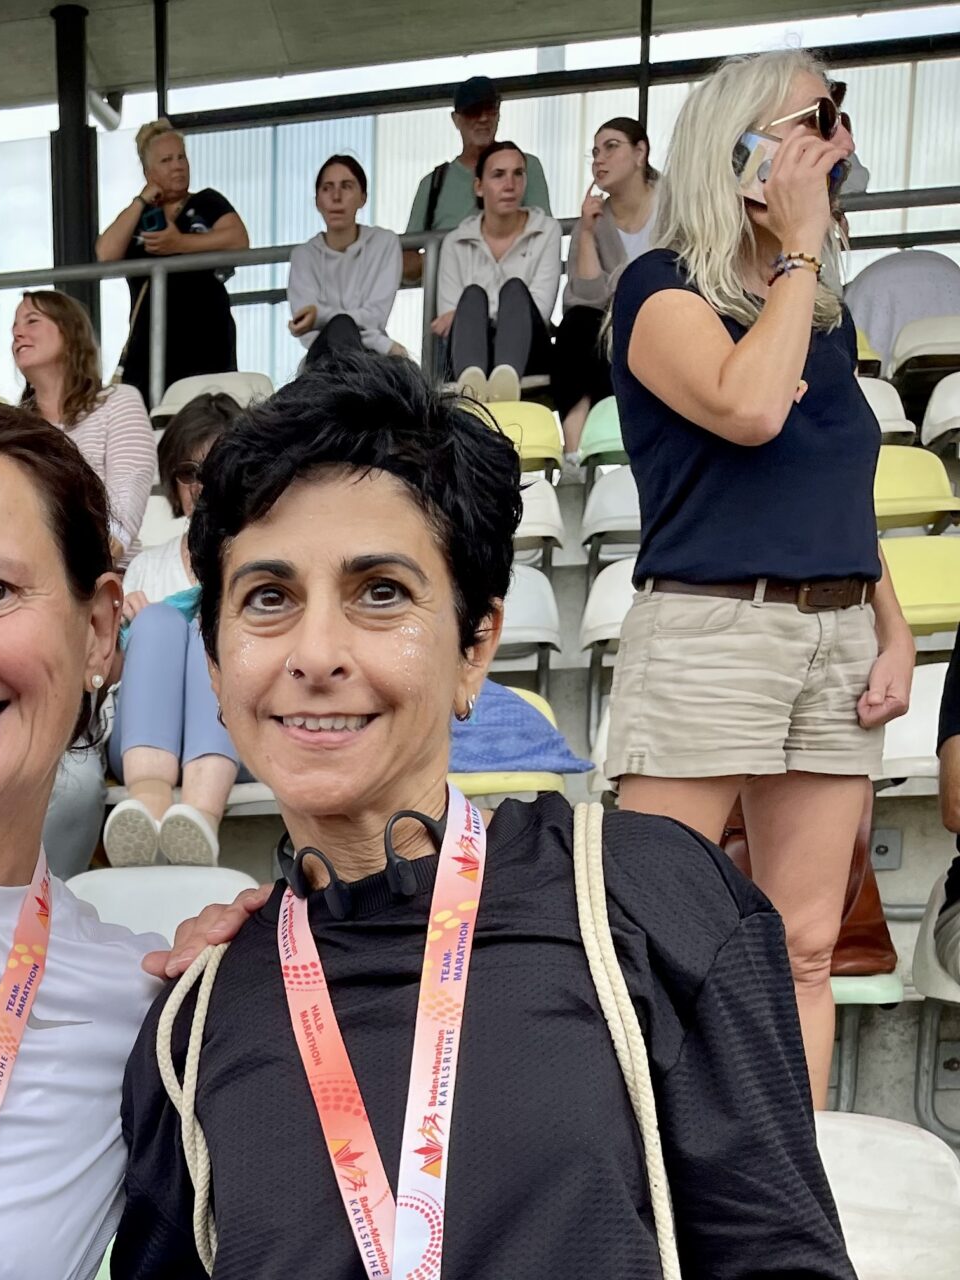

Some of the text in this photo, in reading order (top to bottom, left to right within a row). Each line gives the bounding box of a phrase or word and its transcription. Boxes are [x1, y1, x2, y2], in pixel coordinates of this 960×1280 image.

[281, 907, 293, 961] KARLSRUHE
[453, 921, 470, 982] MARATHON
[15, 962, 40, 1019] MARATHON
[440, 948, 453, 984] TEAM-
[5, 983, 21, 1013] TEAM-
[310, 1004, 324, 1035] HALB-
[298, 1009, 323, 1067] MARATHON
[428, 1029, 445, 1107] Baden-Marathon
[437, 1028, 455, 1107] KARLSRUHE
[349, 1198, 382, 1278] KARLSRUHE
[359, 1195, 390, 1275] Baden-Marathon
